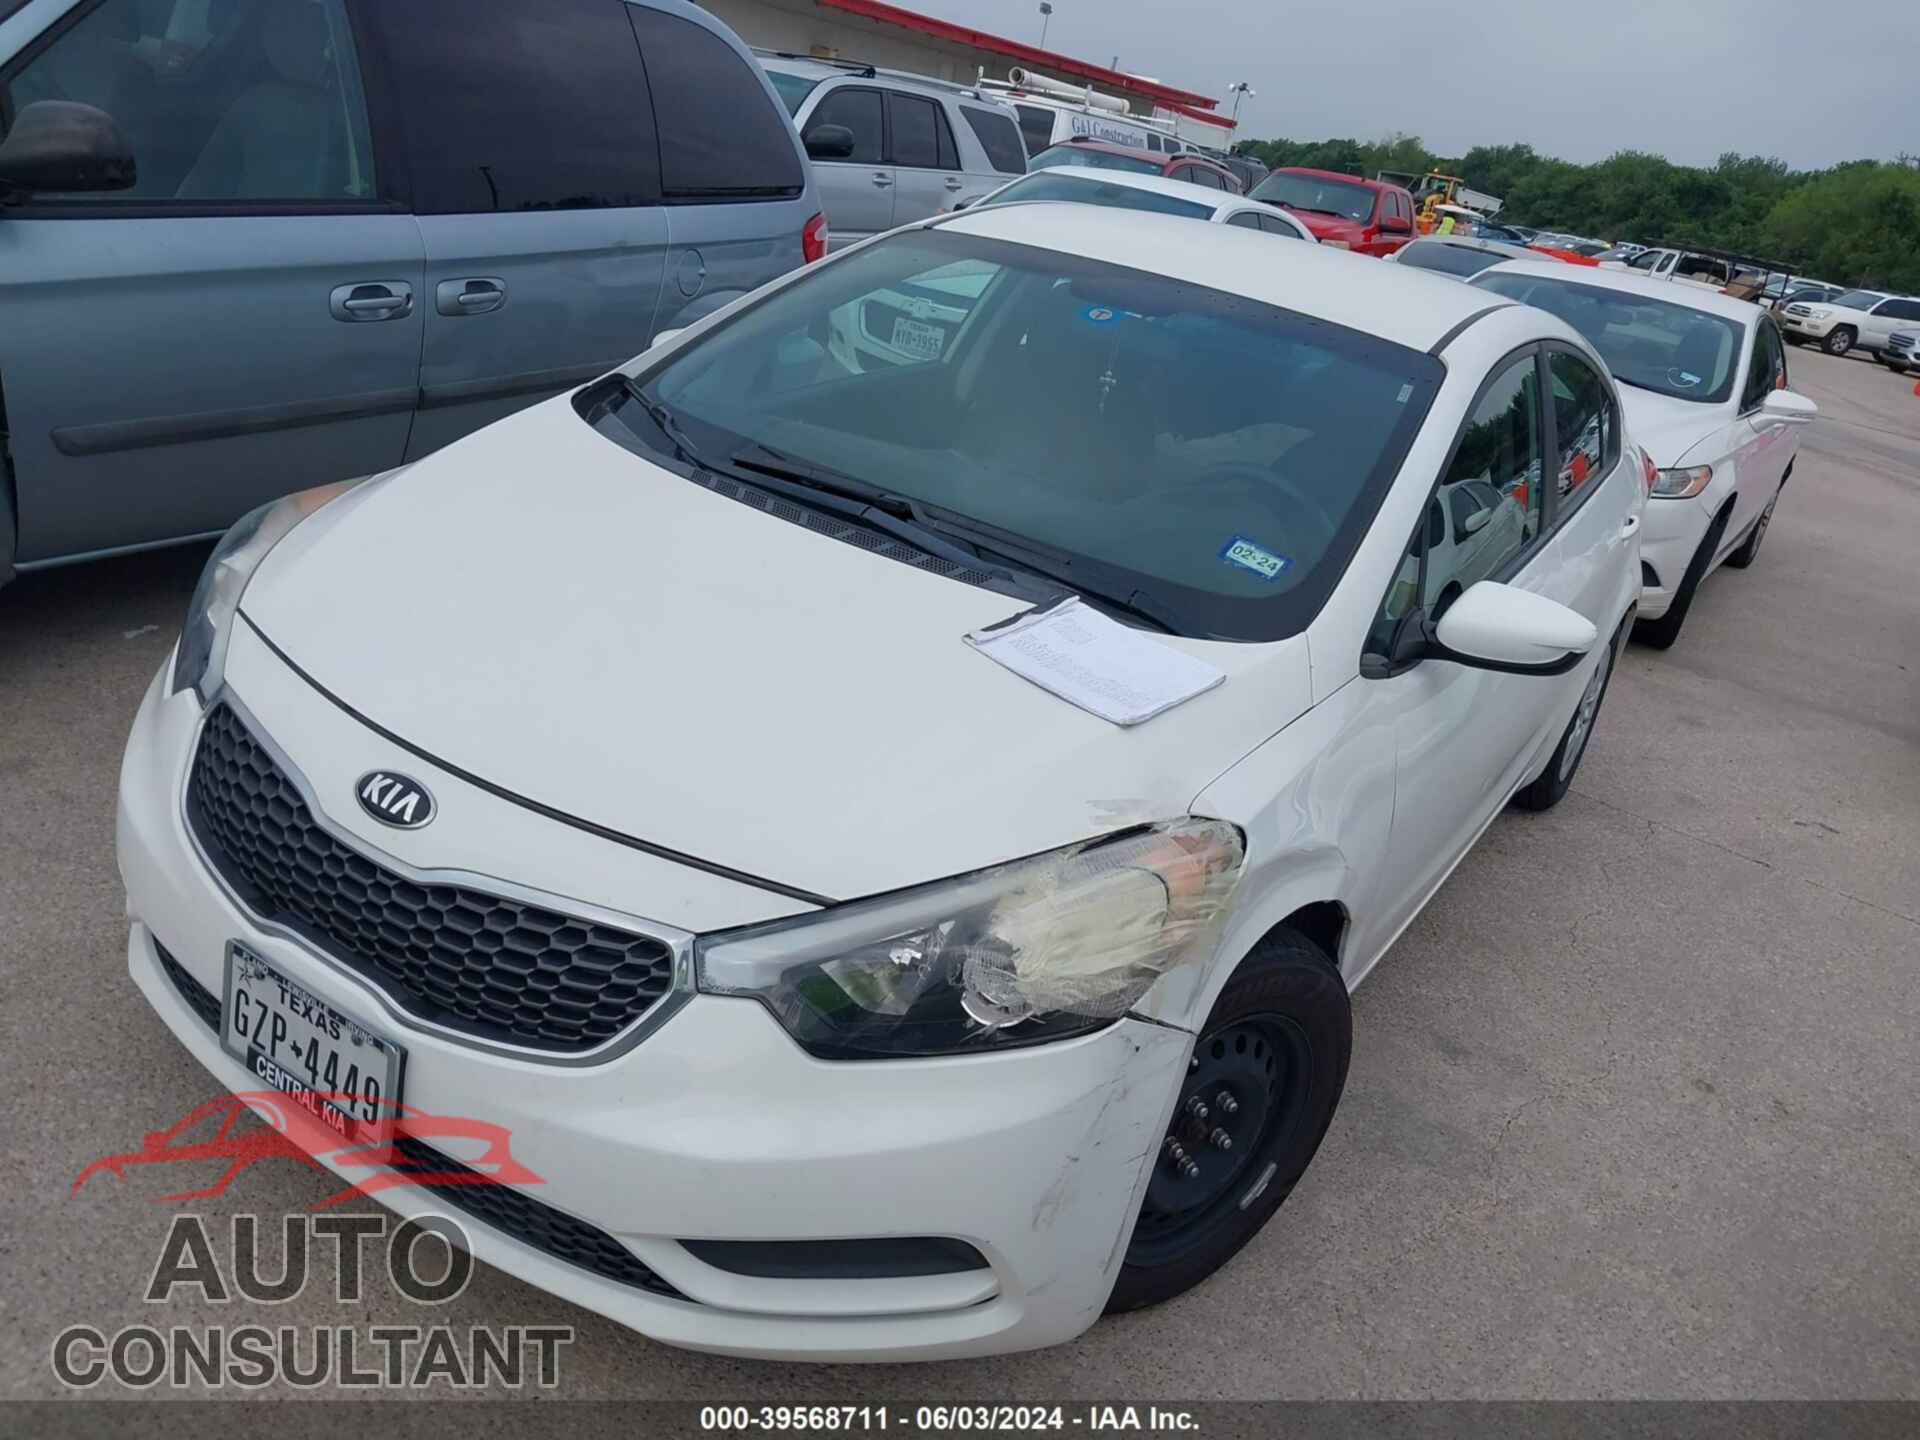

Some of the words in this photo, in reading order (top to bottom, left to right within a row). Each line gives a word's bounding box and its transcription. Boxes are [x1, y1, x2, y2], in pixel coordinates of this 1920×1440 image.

[361, 773, 420, 823] KIA
[278, 984, 341, 1040] TEXAS
[256, 1056, 318, 1114] CENTRAL
[322, 1101, 345, 1135] KIA
